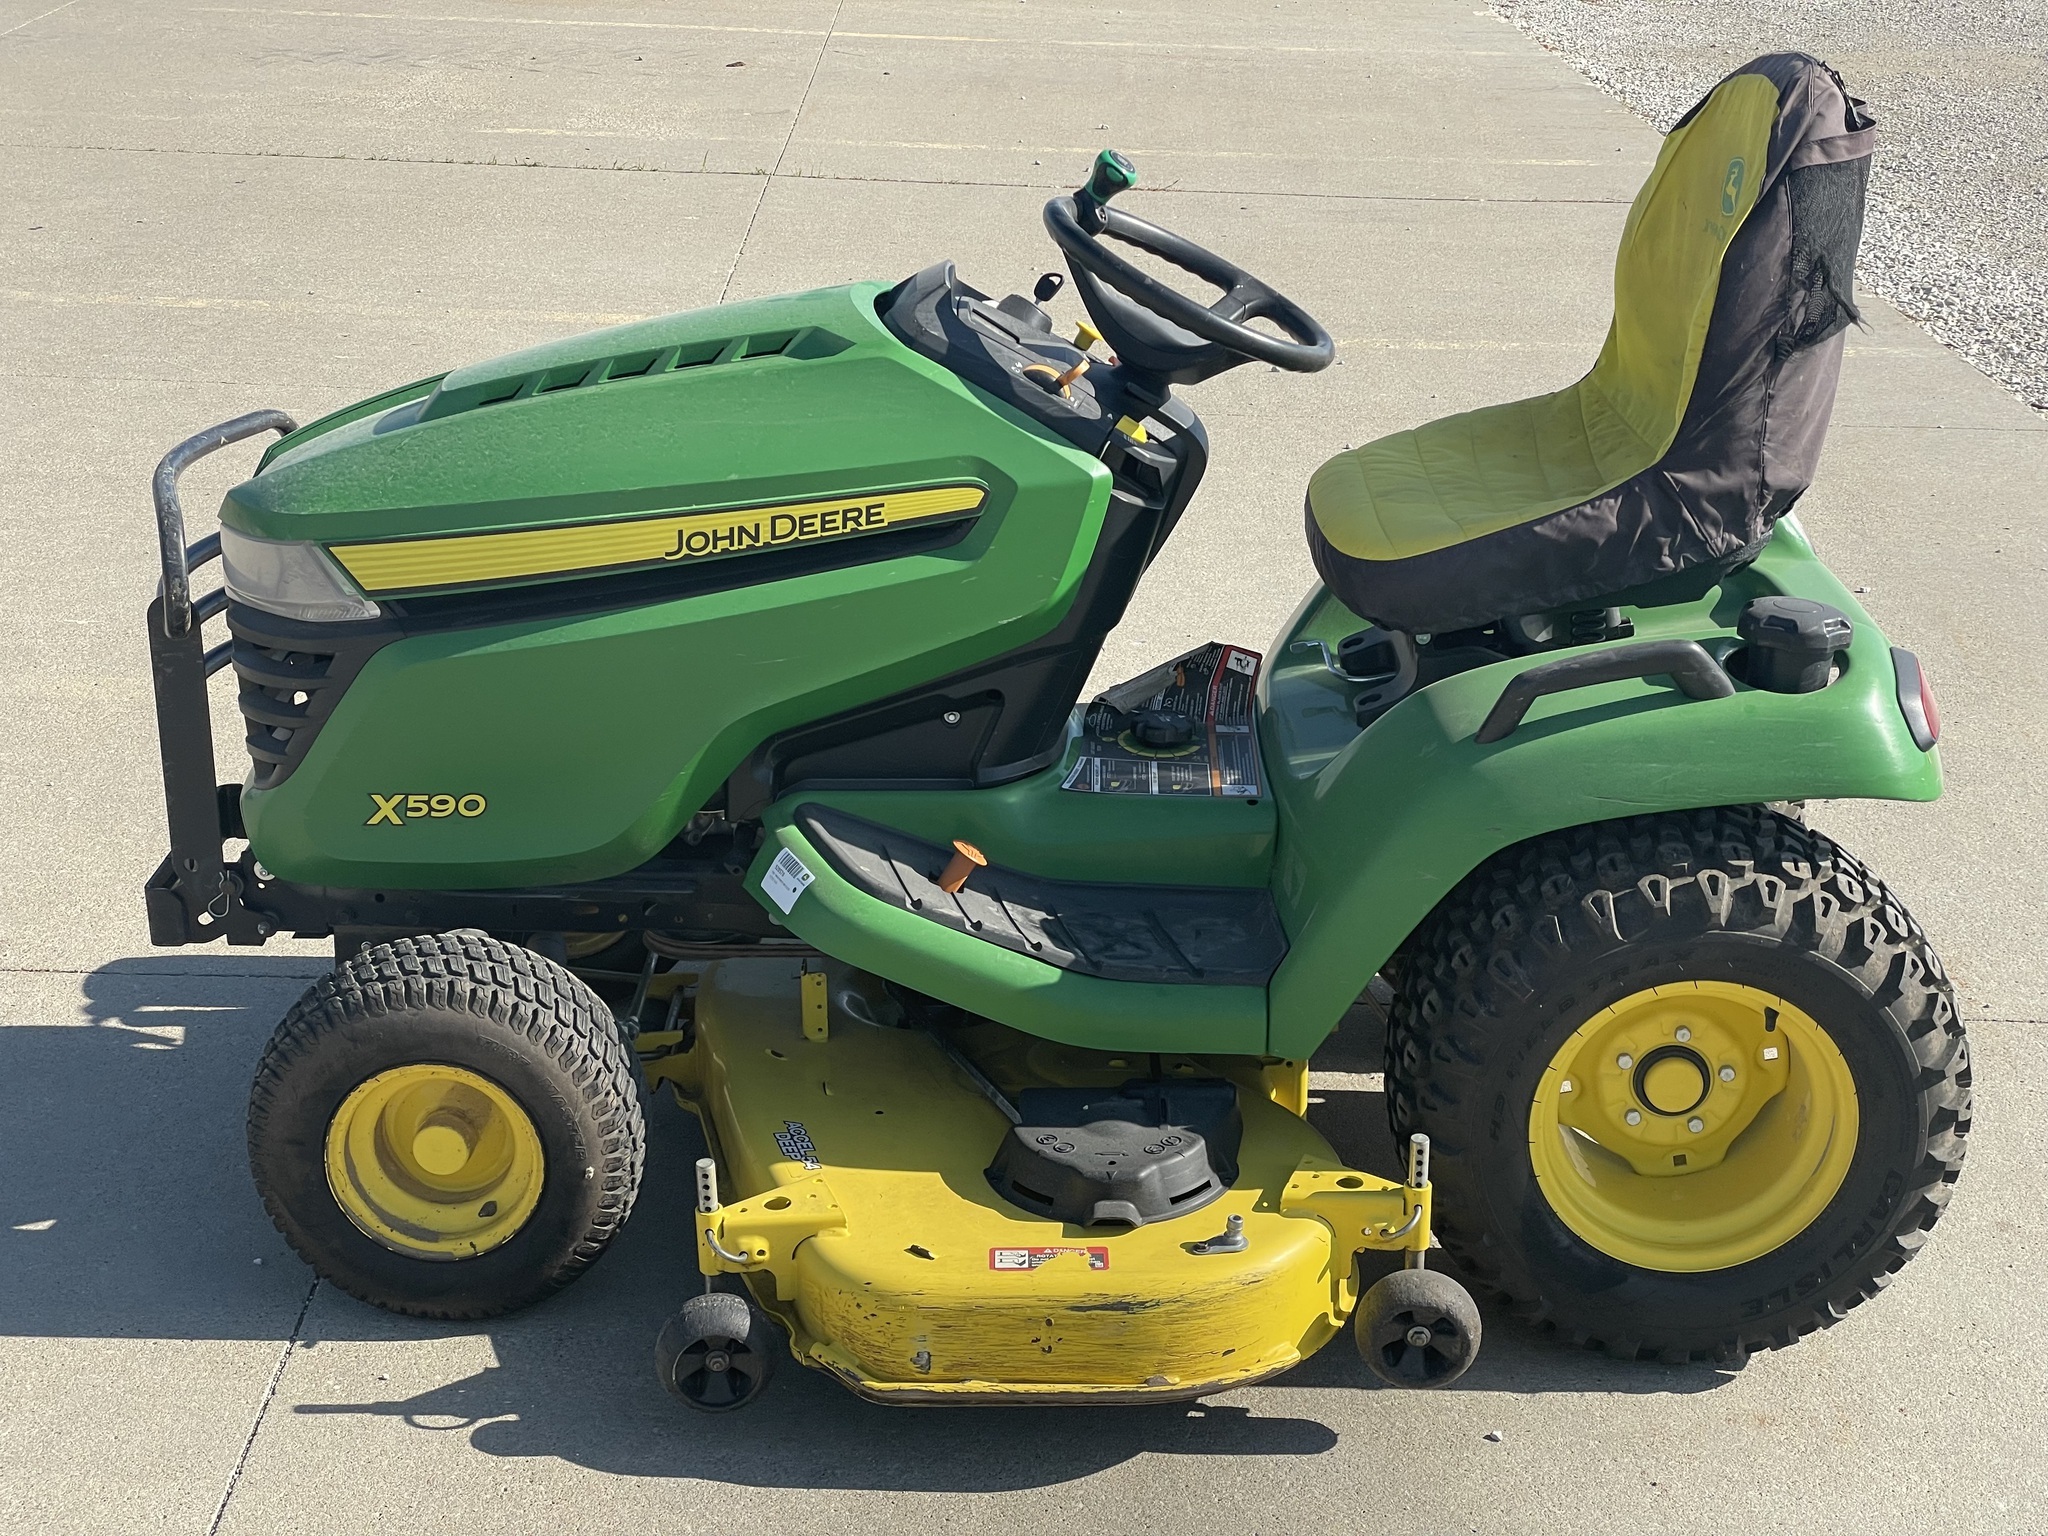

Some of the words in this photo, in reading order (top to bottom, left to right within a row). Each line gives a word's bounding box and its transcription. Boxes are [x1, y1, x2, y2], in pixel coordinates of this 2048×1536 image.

[664, 522, 761, 558] JOHN
[770, 502, 886, 542] DEERE
[364, 793, 487, 826] X590
[477, 1034, 532, 1066] TURF
[540, 1076, 587, 1160] MASTER
[773, 1132, 803, 1161] DEEP
[783, 1119, 817, 1156] ACCEL
[1740, 1169, 1904, 1319] CARLISLE
